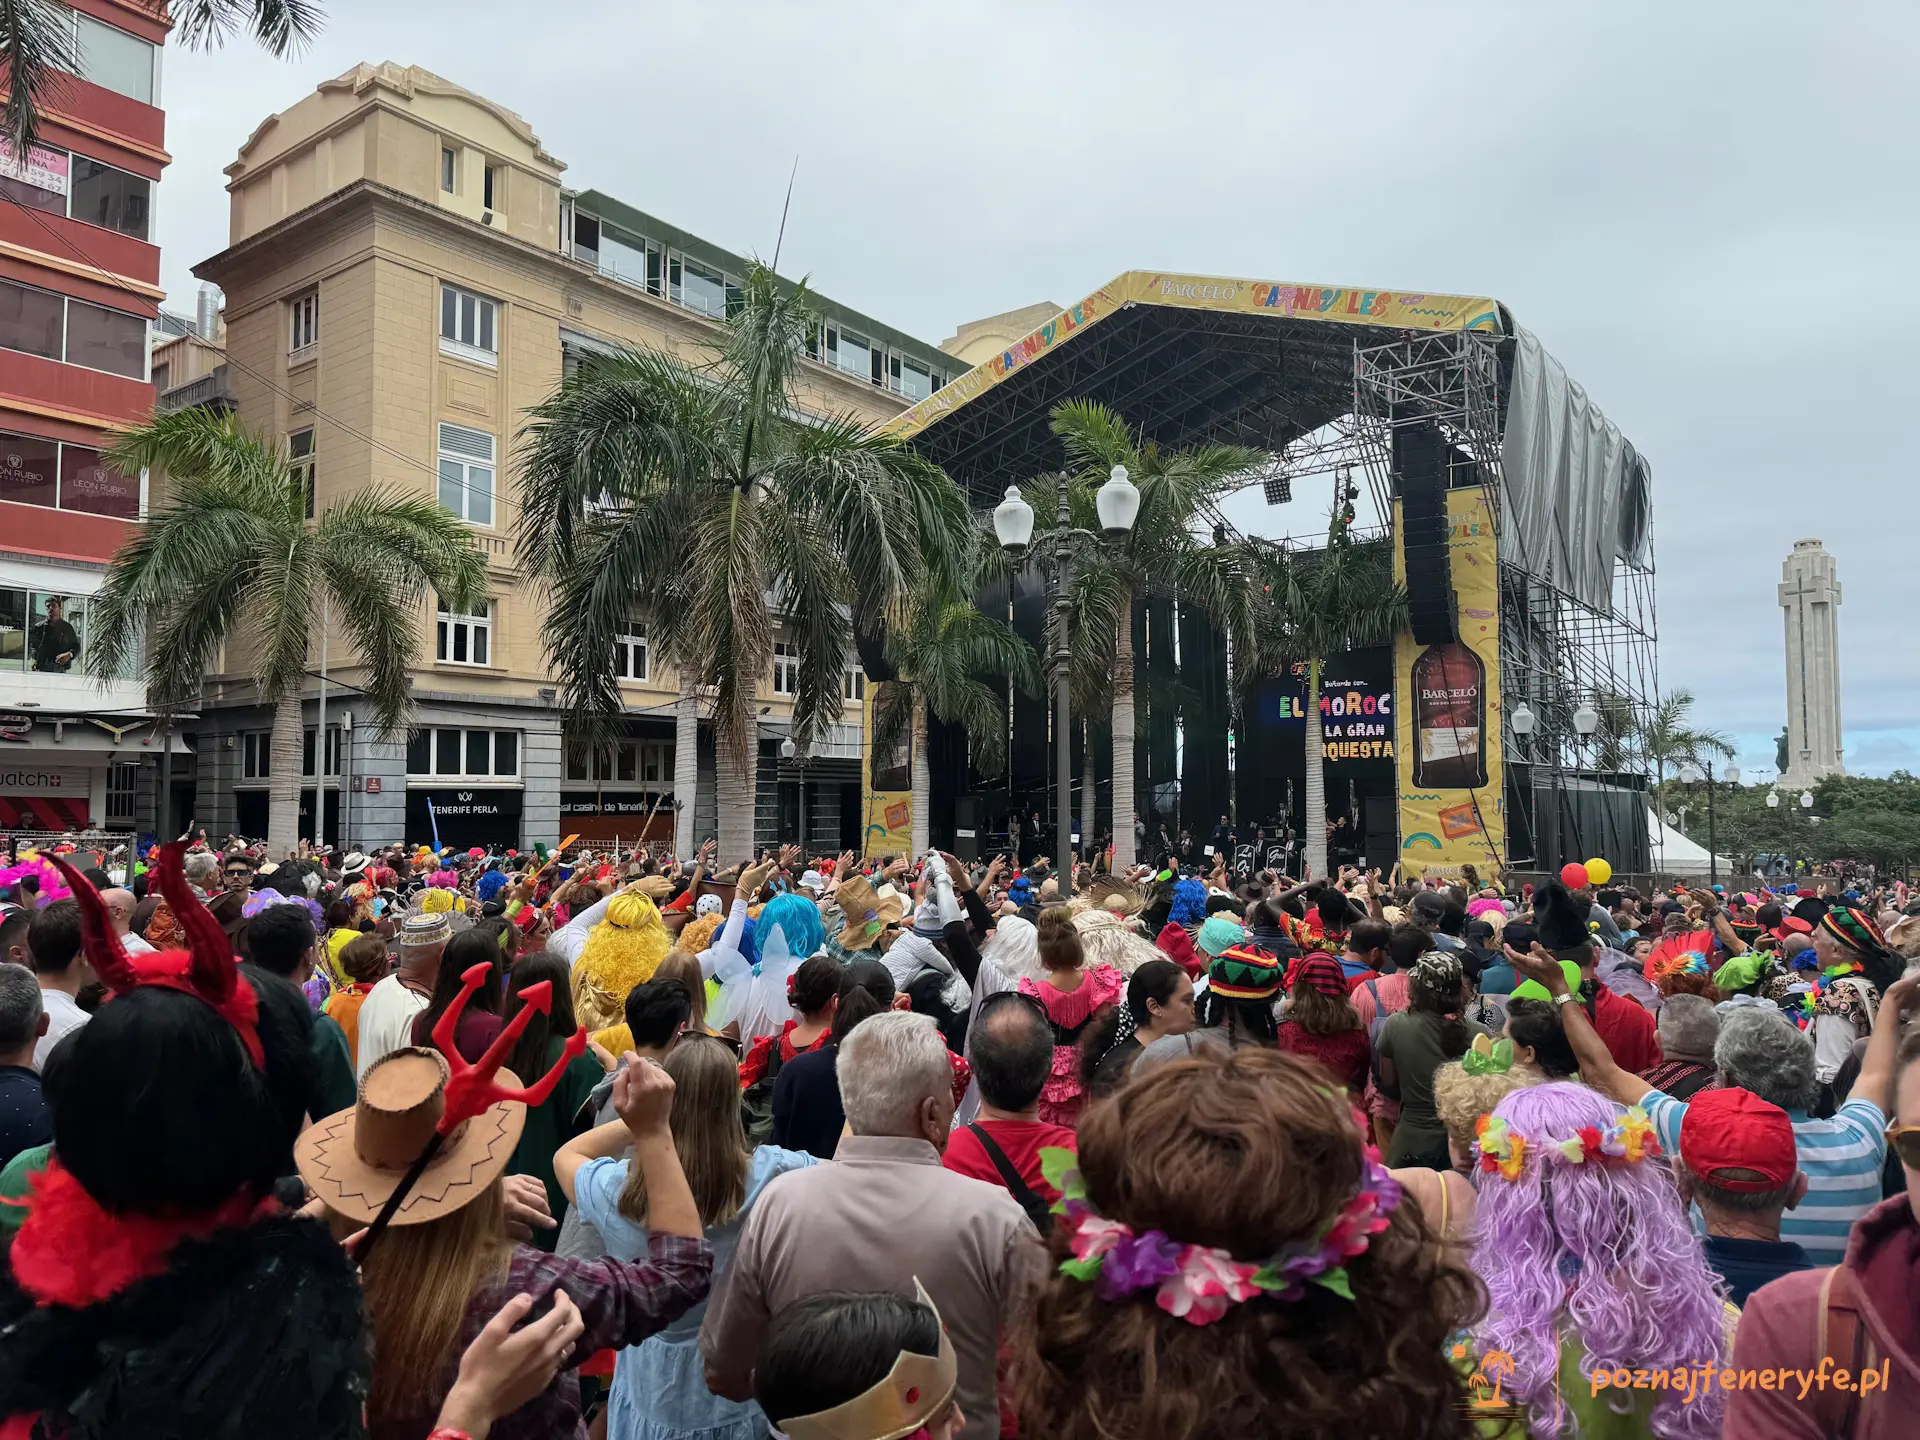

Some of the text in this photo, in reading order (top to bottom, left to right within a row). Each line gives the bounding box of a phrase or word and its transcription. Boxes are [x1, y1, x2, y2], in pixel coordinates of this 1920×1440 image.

[1160, 278, 1392, 317] BARCELÓ CARNAVALES
[989, 297, 1099, 377] CARNAVALES
[14, 469, 44, 481] RUBIO
[100, 483, 127, 495] RUBIO
[1422, 685, 1477, 699] BARCELÓ
[1280, 695, 1305, 718] EL
[1325, 723, 1385, 737] LA GRAN
[431, 805, 499, 815] TENERIFE PERLA
[604, 802, 616, 812] de
[617, 801, 649, 811] Tenerife
